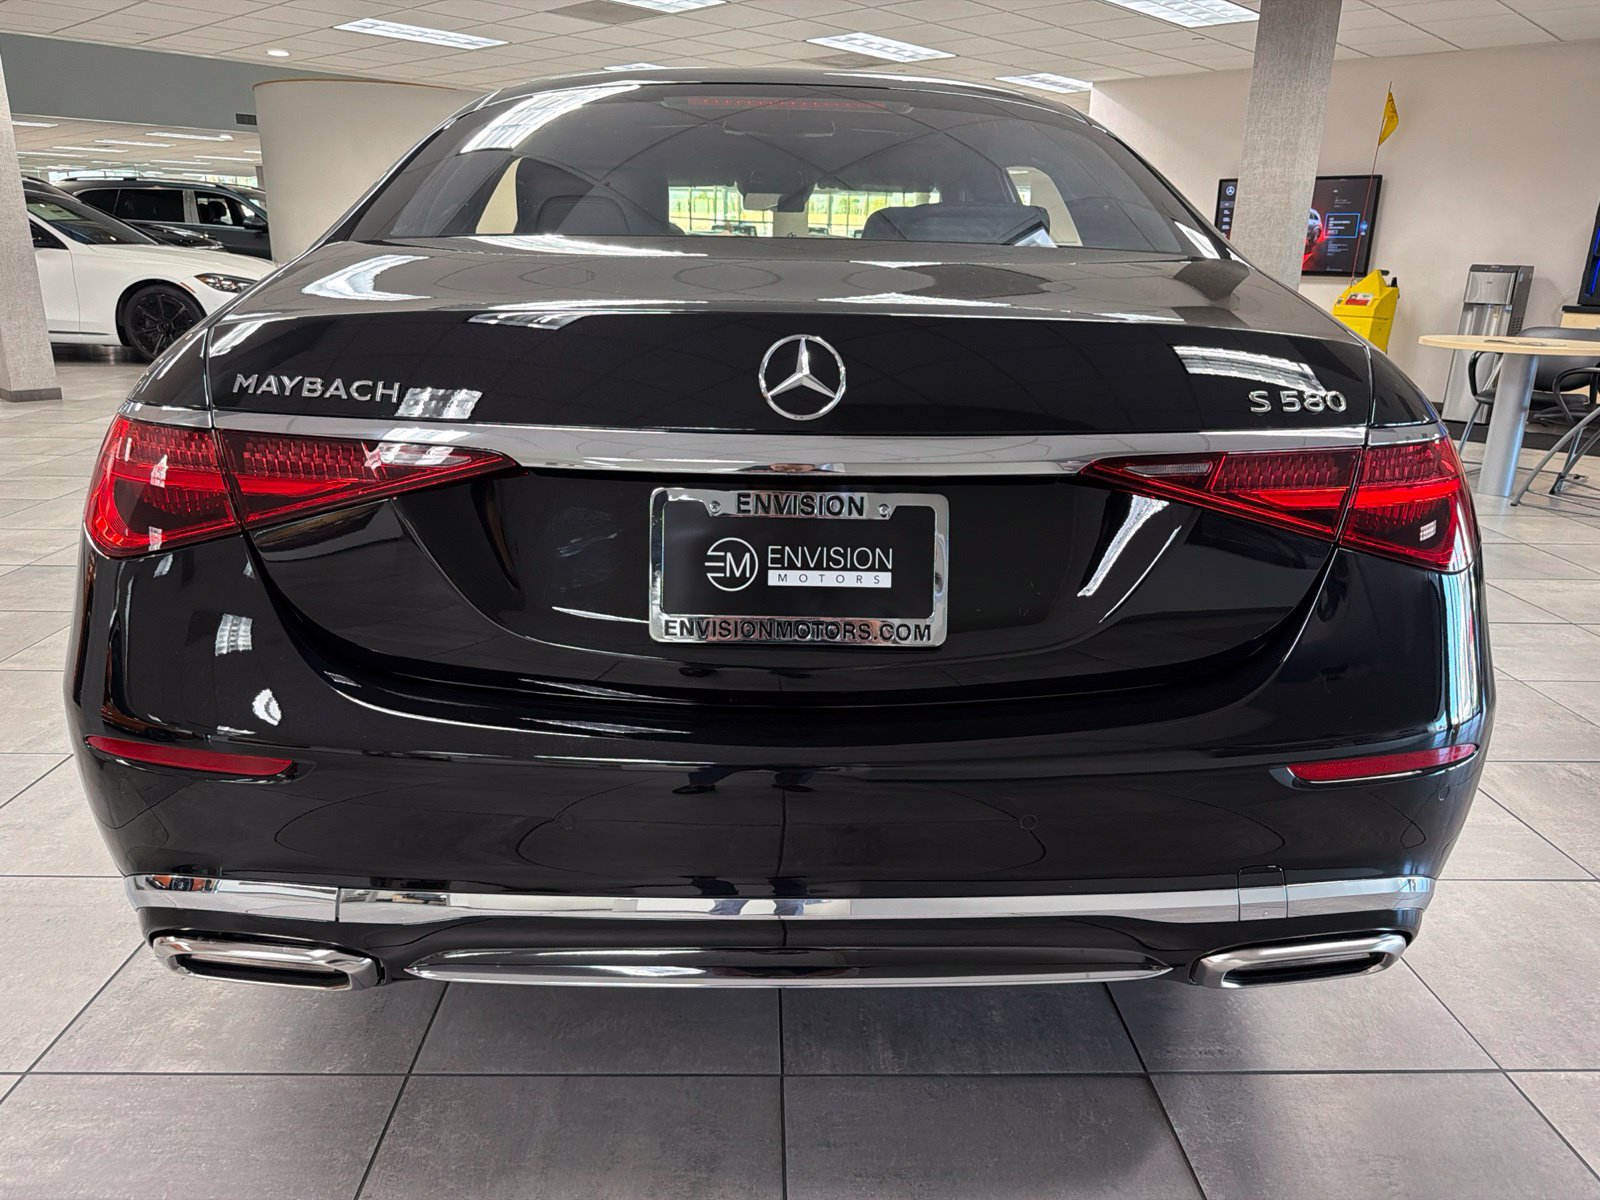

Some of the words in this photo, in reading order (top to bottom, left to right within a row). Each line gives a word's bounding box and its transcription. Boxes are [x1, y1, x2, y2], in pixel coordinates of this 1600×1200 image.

[232, 373, 401, 404] MAYBACH
[1249, 390, 1272, 413] S
[1280, 390, 1347, 413] 580
[736, 492, 865, 517] ENVISION
[768, 545, 893, 570] ENVISION
[777, 573, 881, 585] MOTORS
[664, 619, 932, 642] ENVISIONMOTORS.COM
